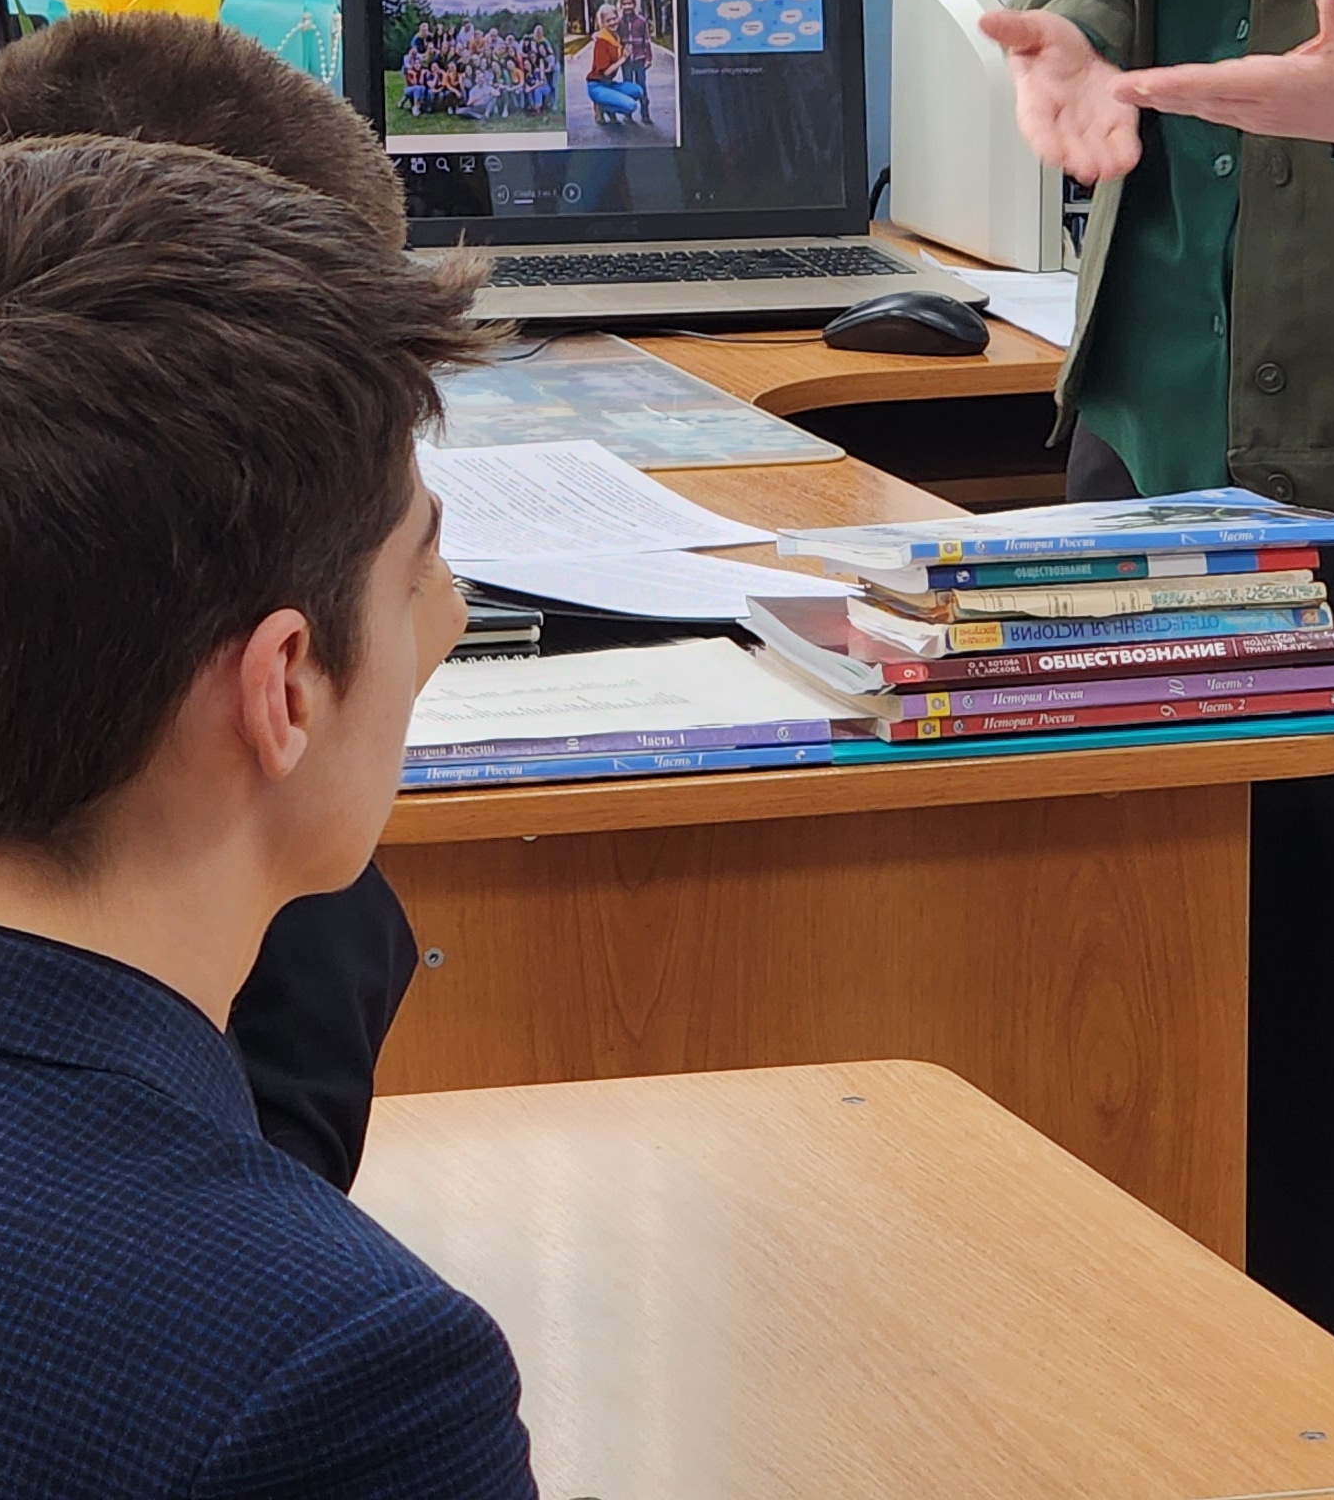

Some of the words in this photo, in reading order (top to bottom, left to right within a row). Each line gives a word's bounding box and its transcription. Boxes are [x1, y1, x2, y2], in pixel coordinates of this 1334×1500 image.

[1004, 538, 1055, 552] История
[1059, 537, 1097, 549] России
[1218, 530, 1255, 543] Часть
[1258, 528, 1267, 541] 2
[1013, 563, 1093, 580] ОБЩЕСТВОЗНАНИЕ
[1010, 622, 1085, 642] ИСТОРИЯ
[1091, 614, 1221, 638] ОТЕЧЕСТВЕННАЯ
[1038, 642, 1227, 672] ОБЩЕСТВОЗНАНИЕ
[992, 690, 1042, 706] История
[1047, 688, 1085, 702] России
[1167, 678, 1186, 698] 10
[1207, 678, 1244, 692] Часть
[1245, 675, 1255, 688] 2
[982, 715, 1035, 730] История
[1038, 711, 1076, 726] России
[1160, 703, 1178, 718] 9
[1198, 700, 1235, 715] Часть
[1236, 698, 1247, 711] 2
[452, 743, 496, 756] России
[567, 737, 580, 752] 10
[636, 733, 675, 748] Часть
[425, 766, 480, 780] История
[484, 763, 524, 777] России
[653, 754, 692, 768] Часть
